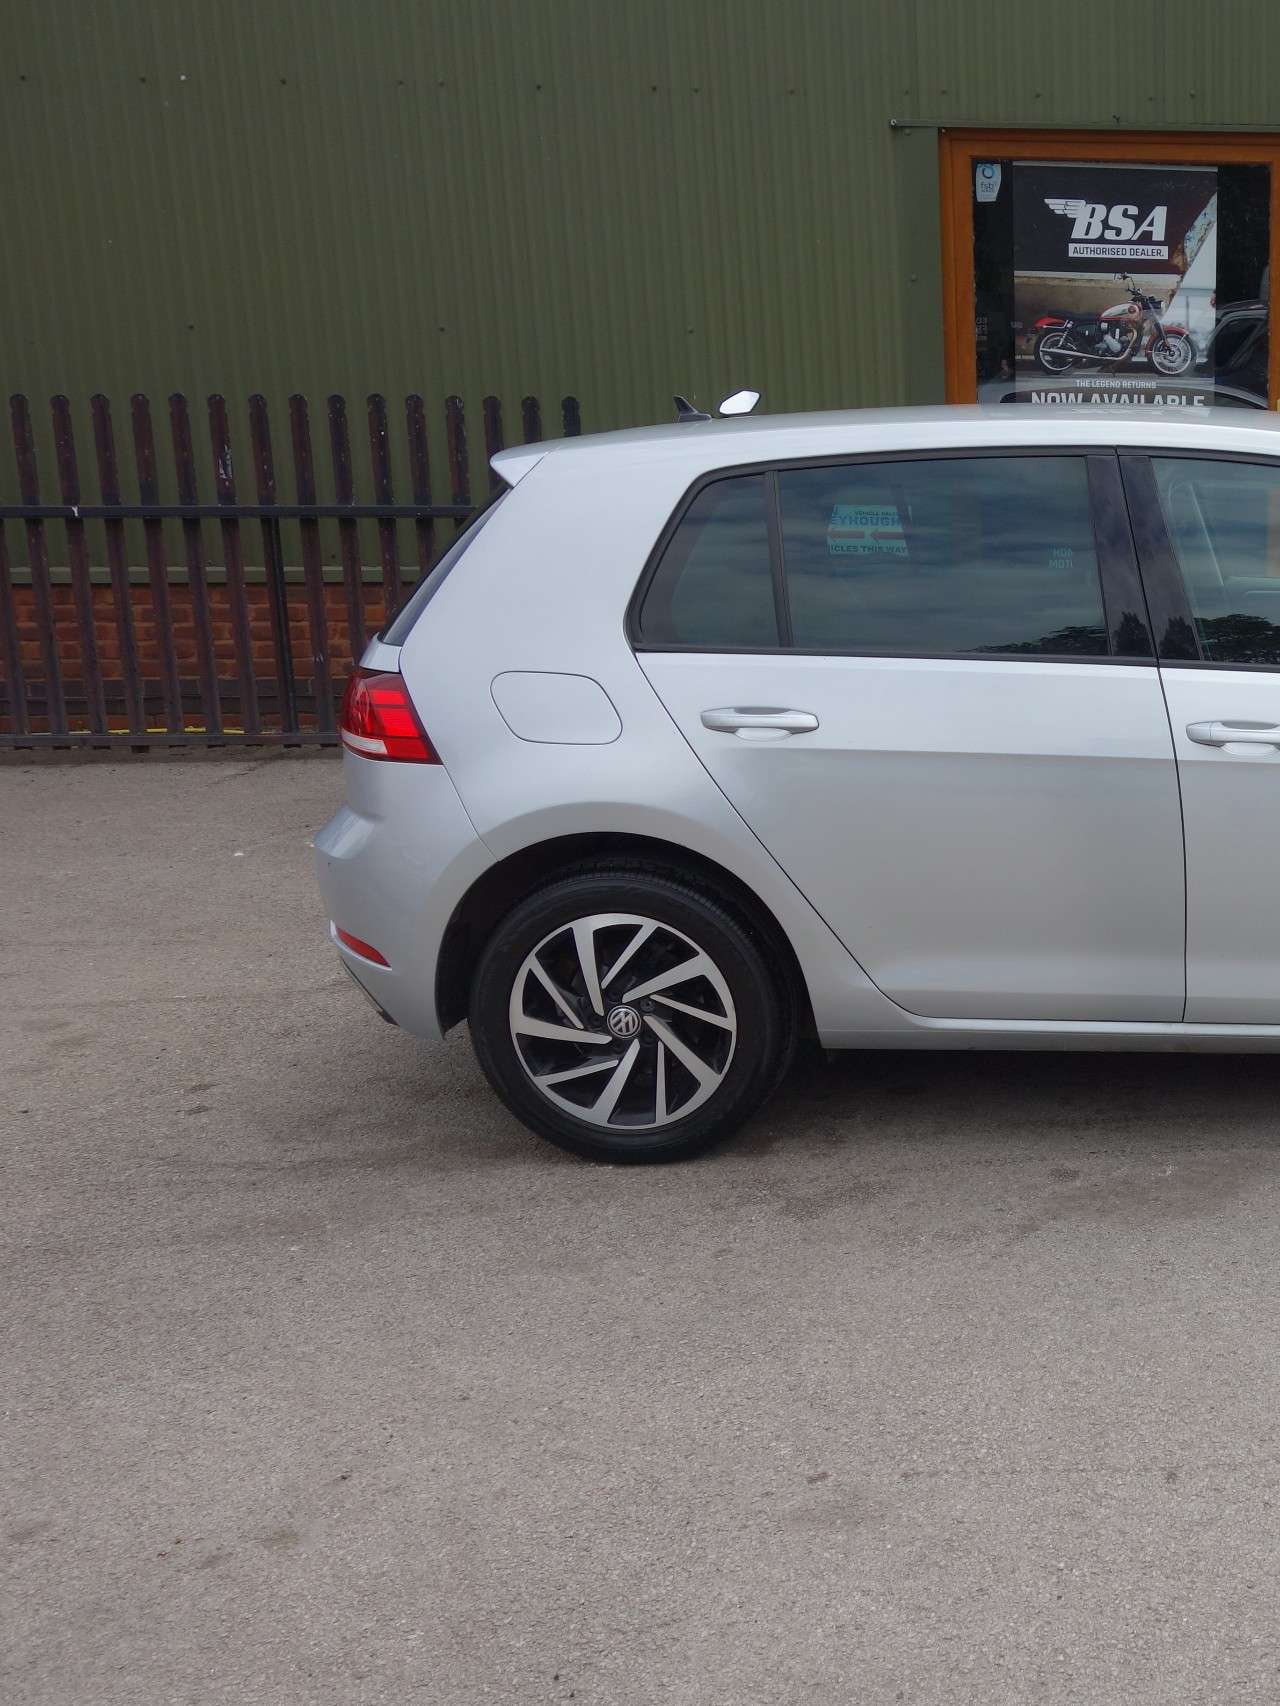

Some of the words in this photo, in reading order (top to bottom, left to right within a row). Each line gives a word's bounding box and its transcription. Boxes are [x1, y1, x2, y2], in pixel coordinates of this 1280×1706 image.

[1070, 203, 1168, 241] BSA
[1072, 246, 1128, 257] AUTHORISED
[1076, 379, 1091, 388] THE
[1092, 380, 1121, 388] LEGEND
[1122, 381, 1157, 389] RETURNS
